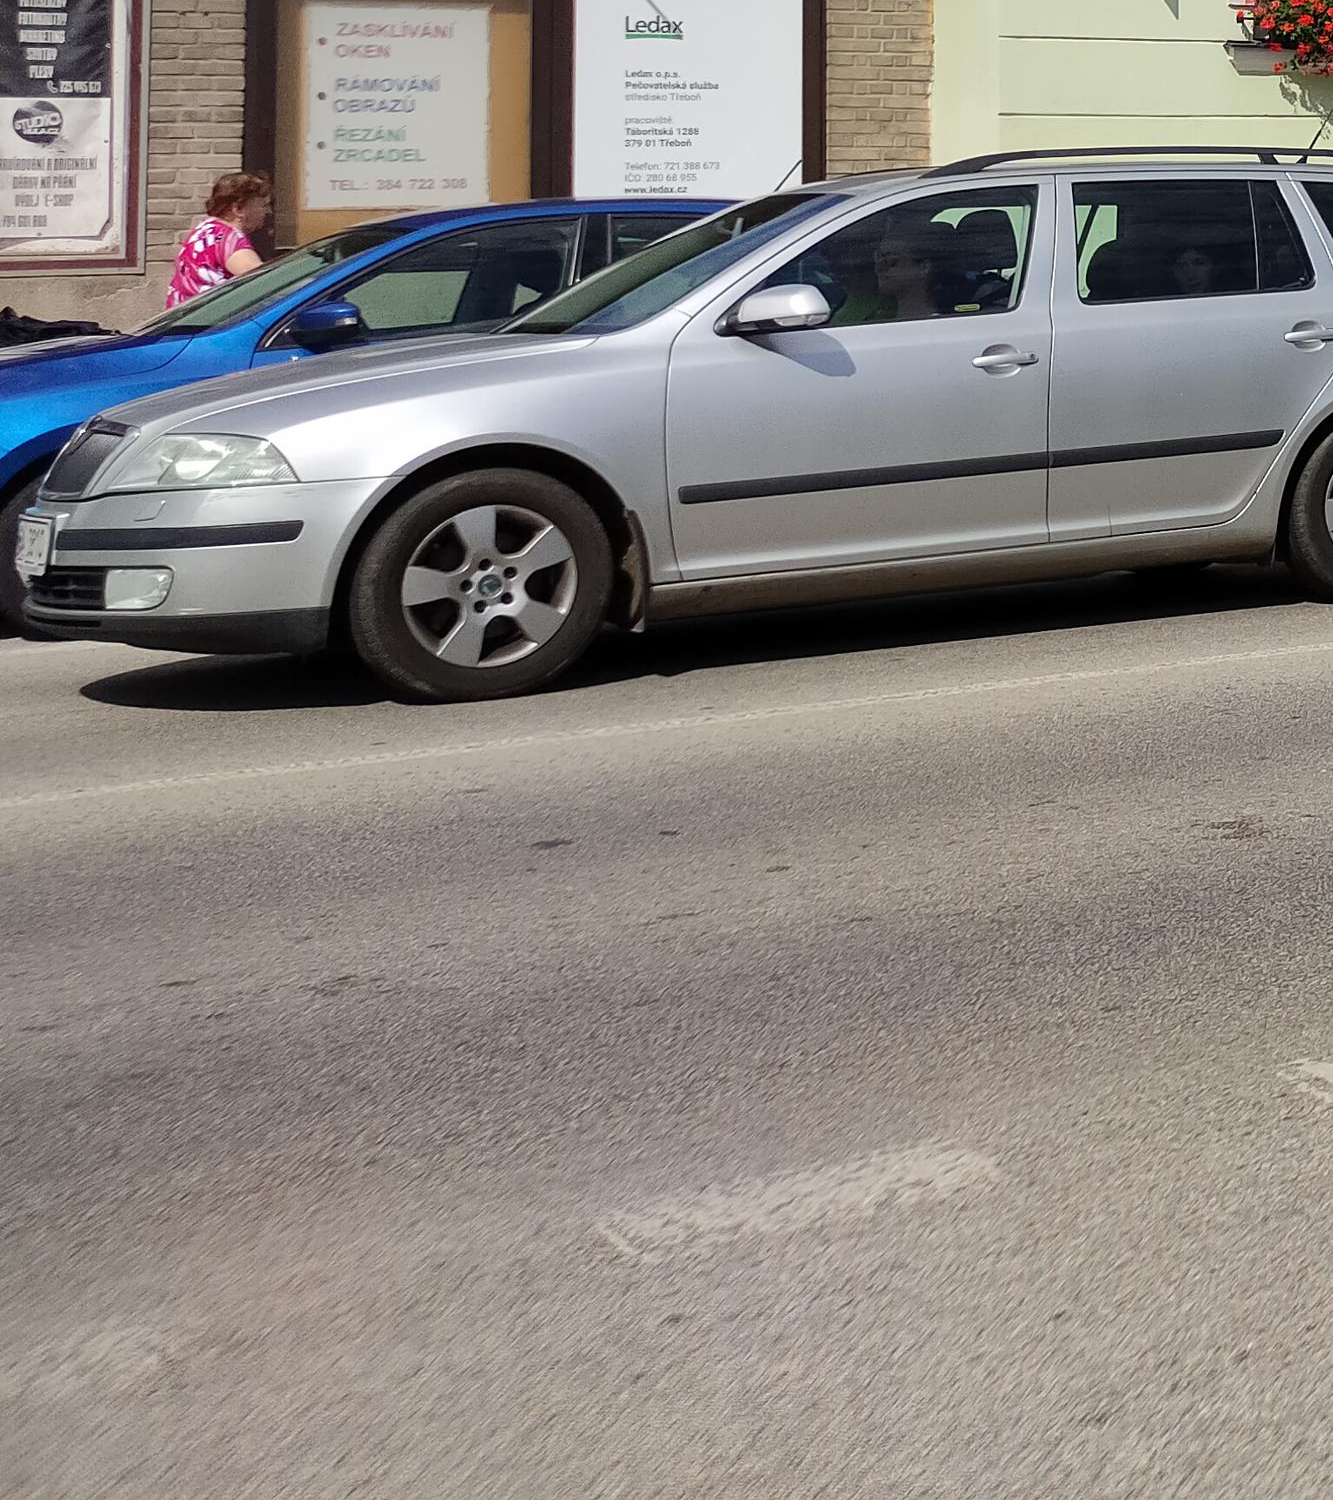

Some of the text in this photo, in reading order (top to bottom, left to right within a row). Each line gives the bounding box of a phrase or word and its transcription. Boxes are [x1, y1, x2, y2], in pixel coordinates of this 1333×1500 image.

[335, 21, 456, 39] ZASKLÍVÁNÍ
[624, 15, 684, 34] Ledax
[334, 43, 392, 59] OKEN
[625, 70, 681, 79] Ledax o.p.s.
[333, 74, 442, 93] RÁMOVÁNÍ
[15, 111, 62, 131] STUDIO
[676, 127, 700, 136] 1288
[624, 139, 643, 148] 379
[645, 139, 656, 148] 01
[332, 148, 427, 163] ZRCADEL
[408, 178, 435, 190] 722
[624, 185, 688, 194] www.ledax.cz
